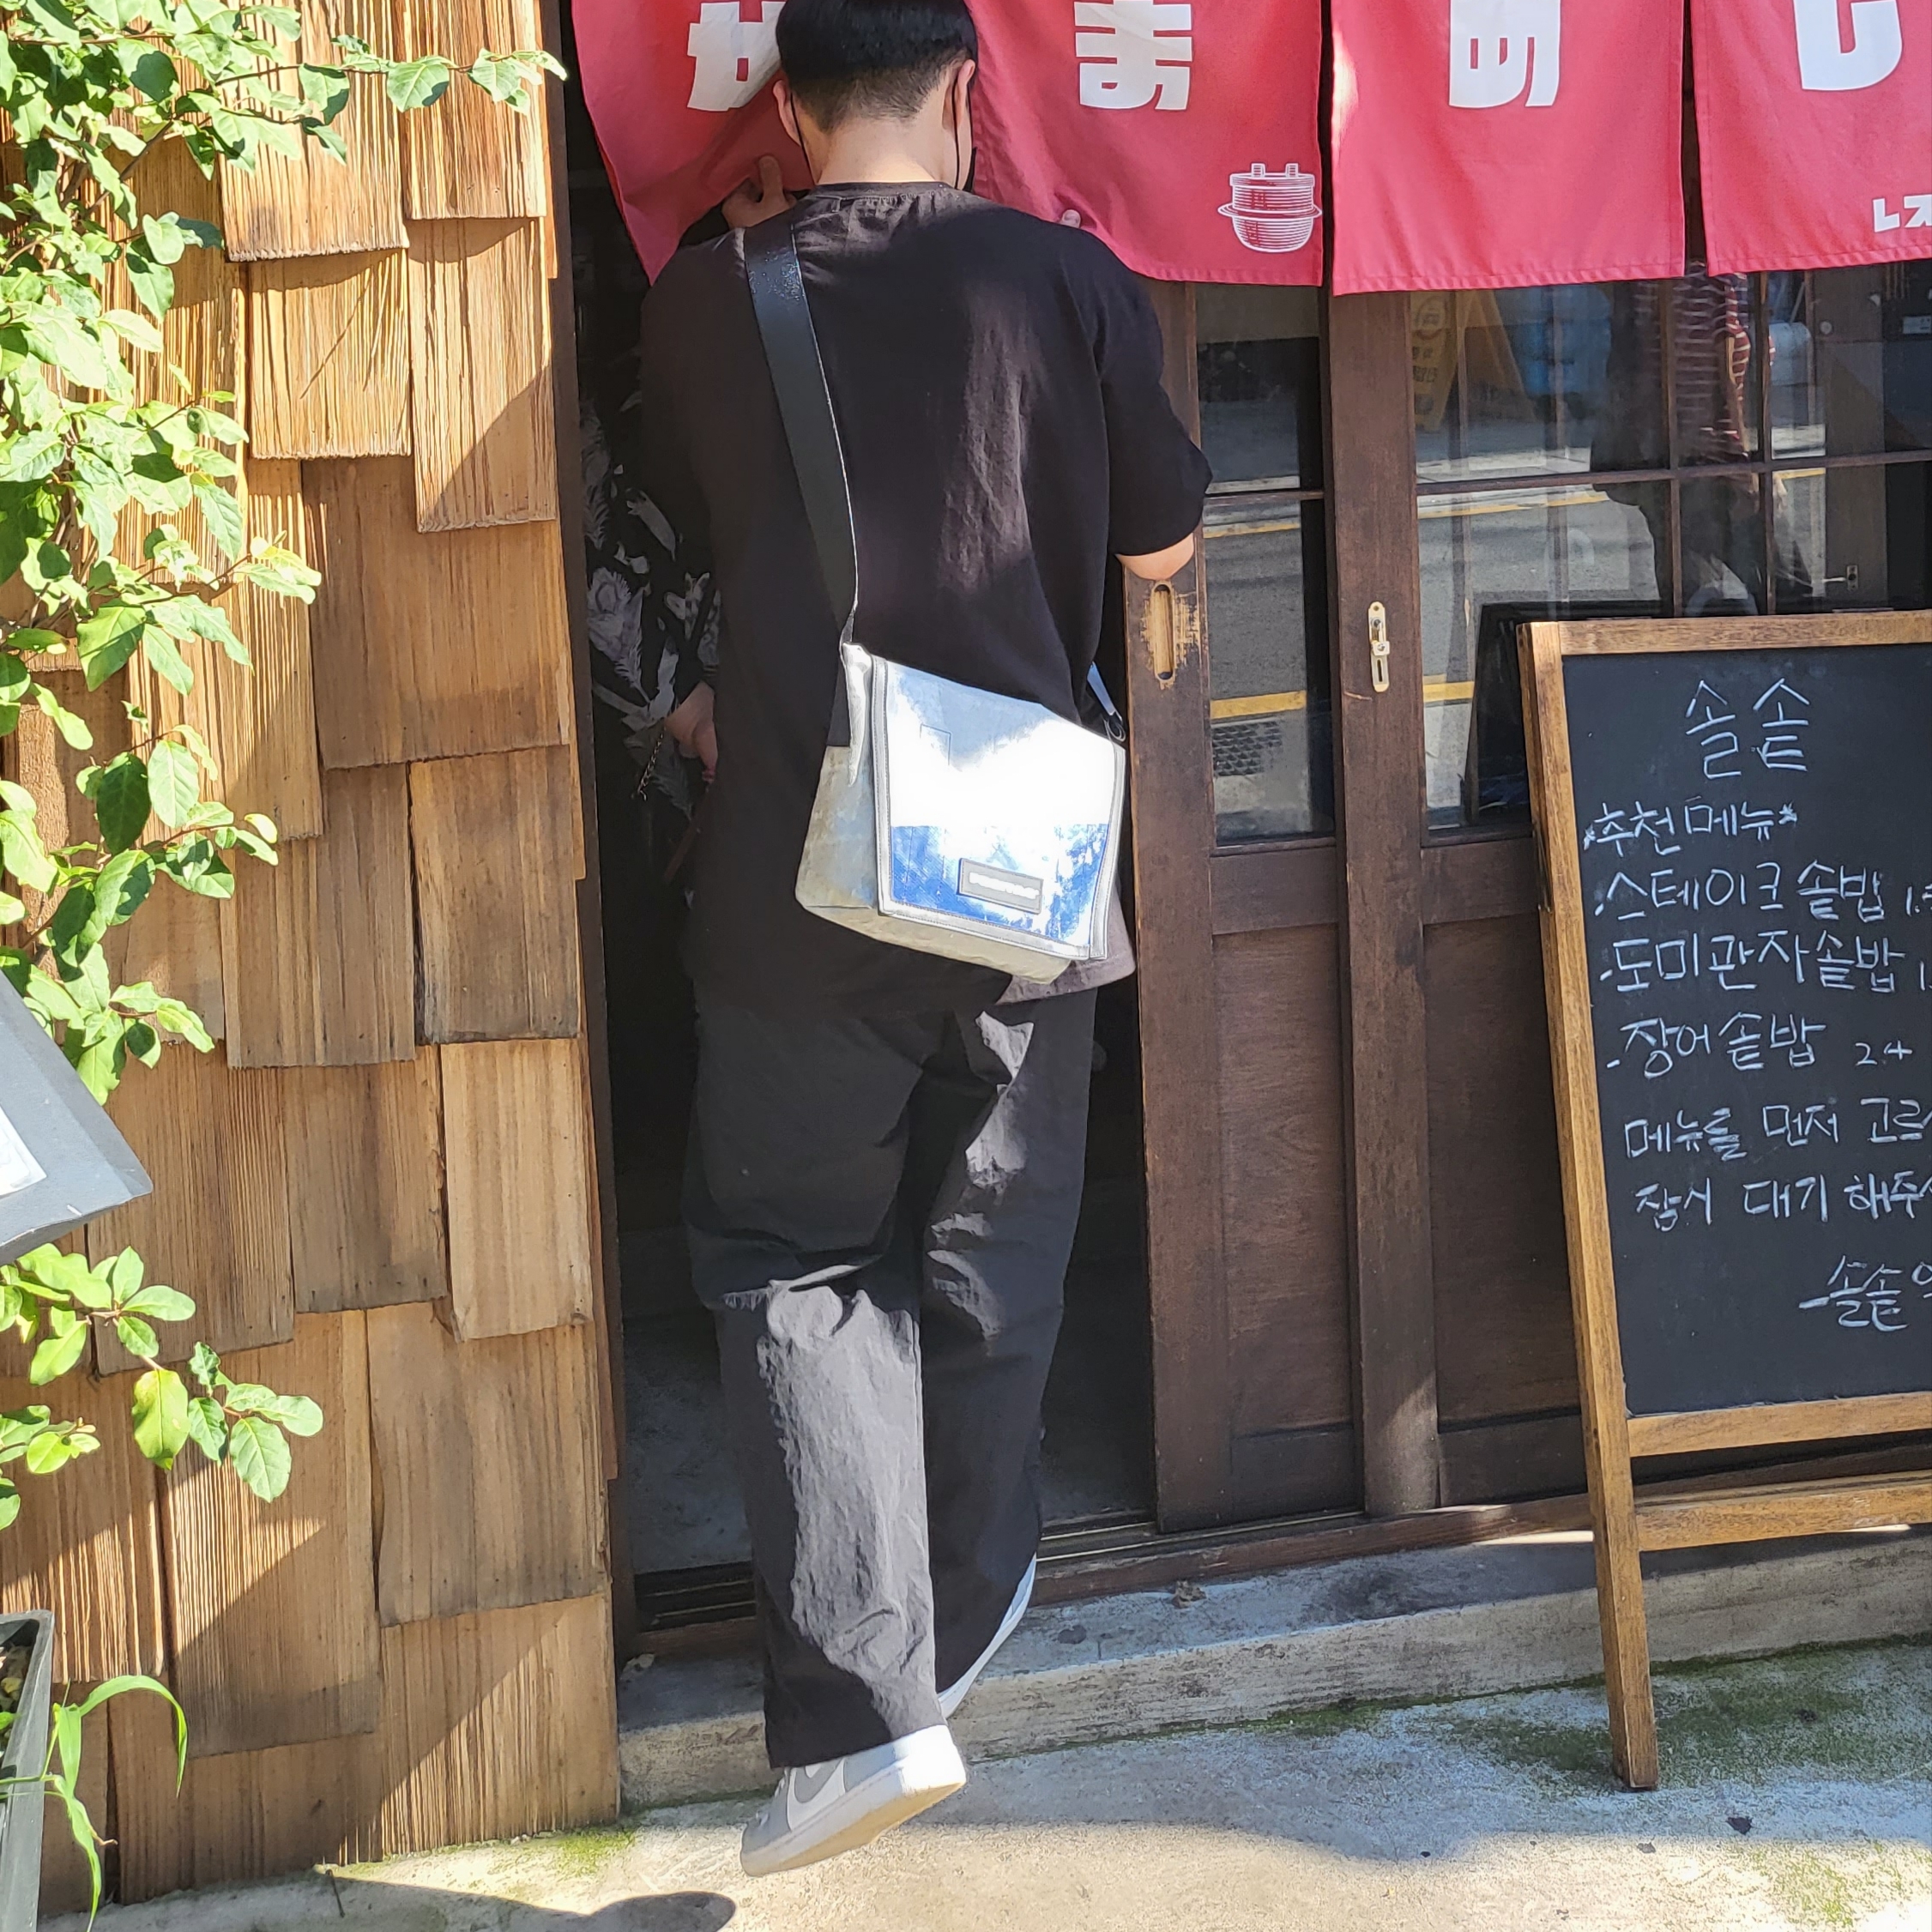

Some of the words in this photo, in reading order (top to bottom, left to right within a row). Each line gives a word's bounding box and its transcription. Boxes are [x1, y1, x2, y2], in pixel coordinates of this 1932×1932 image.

[1624, 1108, 1748, 1162] 메뉴를
[1762, 1104, 1838, 1148] 먼저
[1634, 1176, 1712, 1232] 잠시
